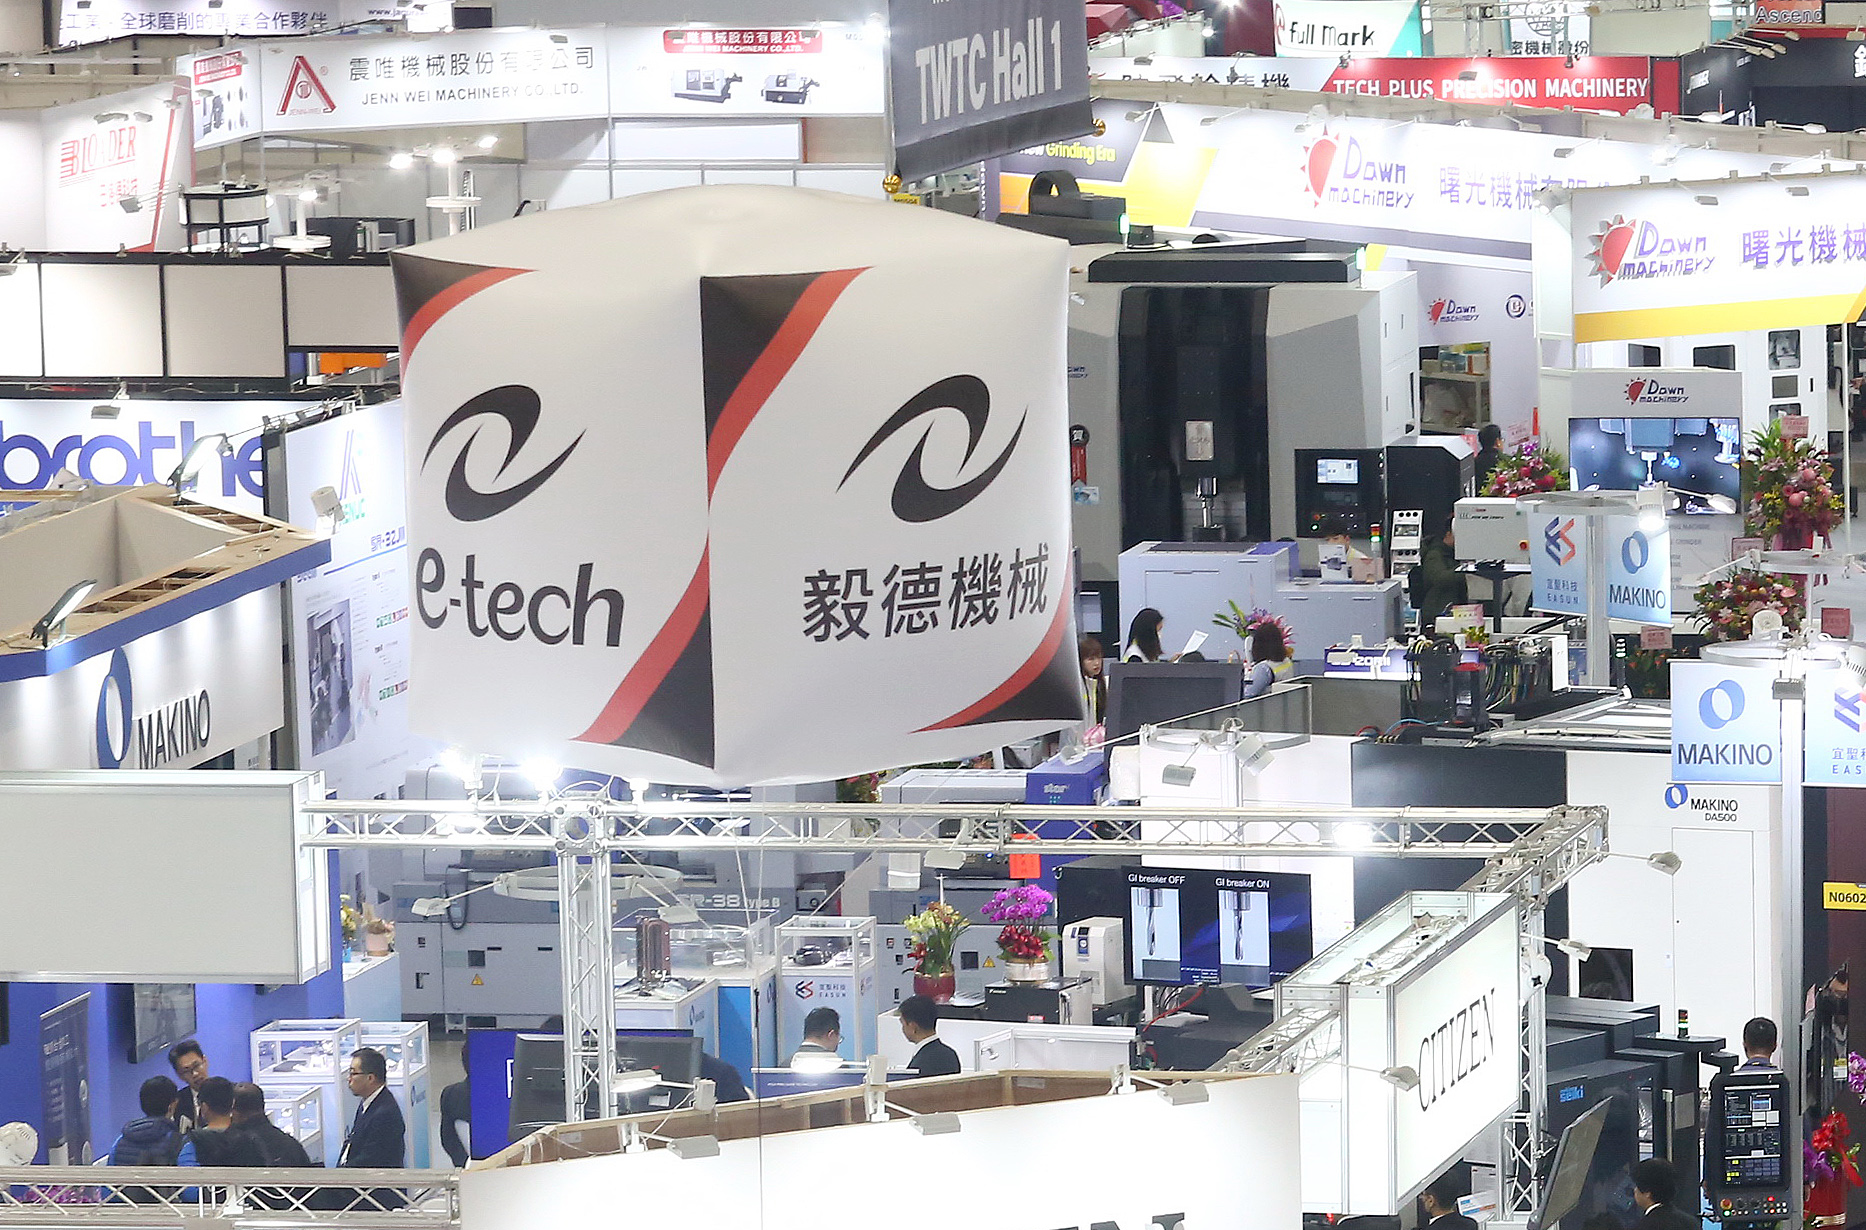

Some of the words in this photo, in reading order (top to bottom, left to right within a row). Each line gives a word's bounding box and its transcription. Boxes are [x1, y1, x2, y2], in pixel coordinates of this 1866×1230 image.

[915, 33, 987, 125] TWTC
[993, 17, 1045, 105] Hall
[1050, 20, 1064, 91] 1
[361, 91, 399, 106] JENN
[405, 91, 432, 104] WEI
[435, 86, 519, 102] MACHINERY
[1333, 79, 1380, 97] TECH
[1388, 79, 1435, 98] PLUS
[1441, 78, 1537, 99] PRECISION
[1545, 77, 1648, 99] MACHINERY
[1045, 142, 1095, 165] Grinding
[1096, 145, 1116, 162] Era
[1343, 136, 1407, 184] Dawn
[1328, 186, 1415, 210] machinery
[1636, 220, 1708, 258] Dawn
[1618, 254, 1716, 282] machinery
[1446, 300, 1477, 315] Dawn
[1646, 379, 1686, 396] Dawn
[415, 546, 626, 650] e-tech
[801, 541, 1051, 645] 毅德機械
[1547, 593, 1579, 605] EASUN
[1609, 582, 1667, 610] MAKINO
[138, 688, 211, 770] MAKINO
[1677, 743, 1774, 767] MAKINO
[1690, 798, 1739, 812] MAKINO
[1704, 812, 1738, 822] DA500
[1139, 874, 1167, 884] breaker
[1168, 875, 1186, 885] OFF
[1226, 878, 1255, 888] breaker
[1256, 879, 1270, 888] ON
[1418, 987, 1495, 1113] CITIZEN
